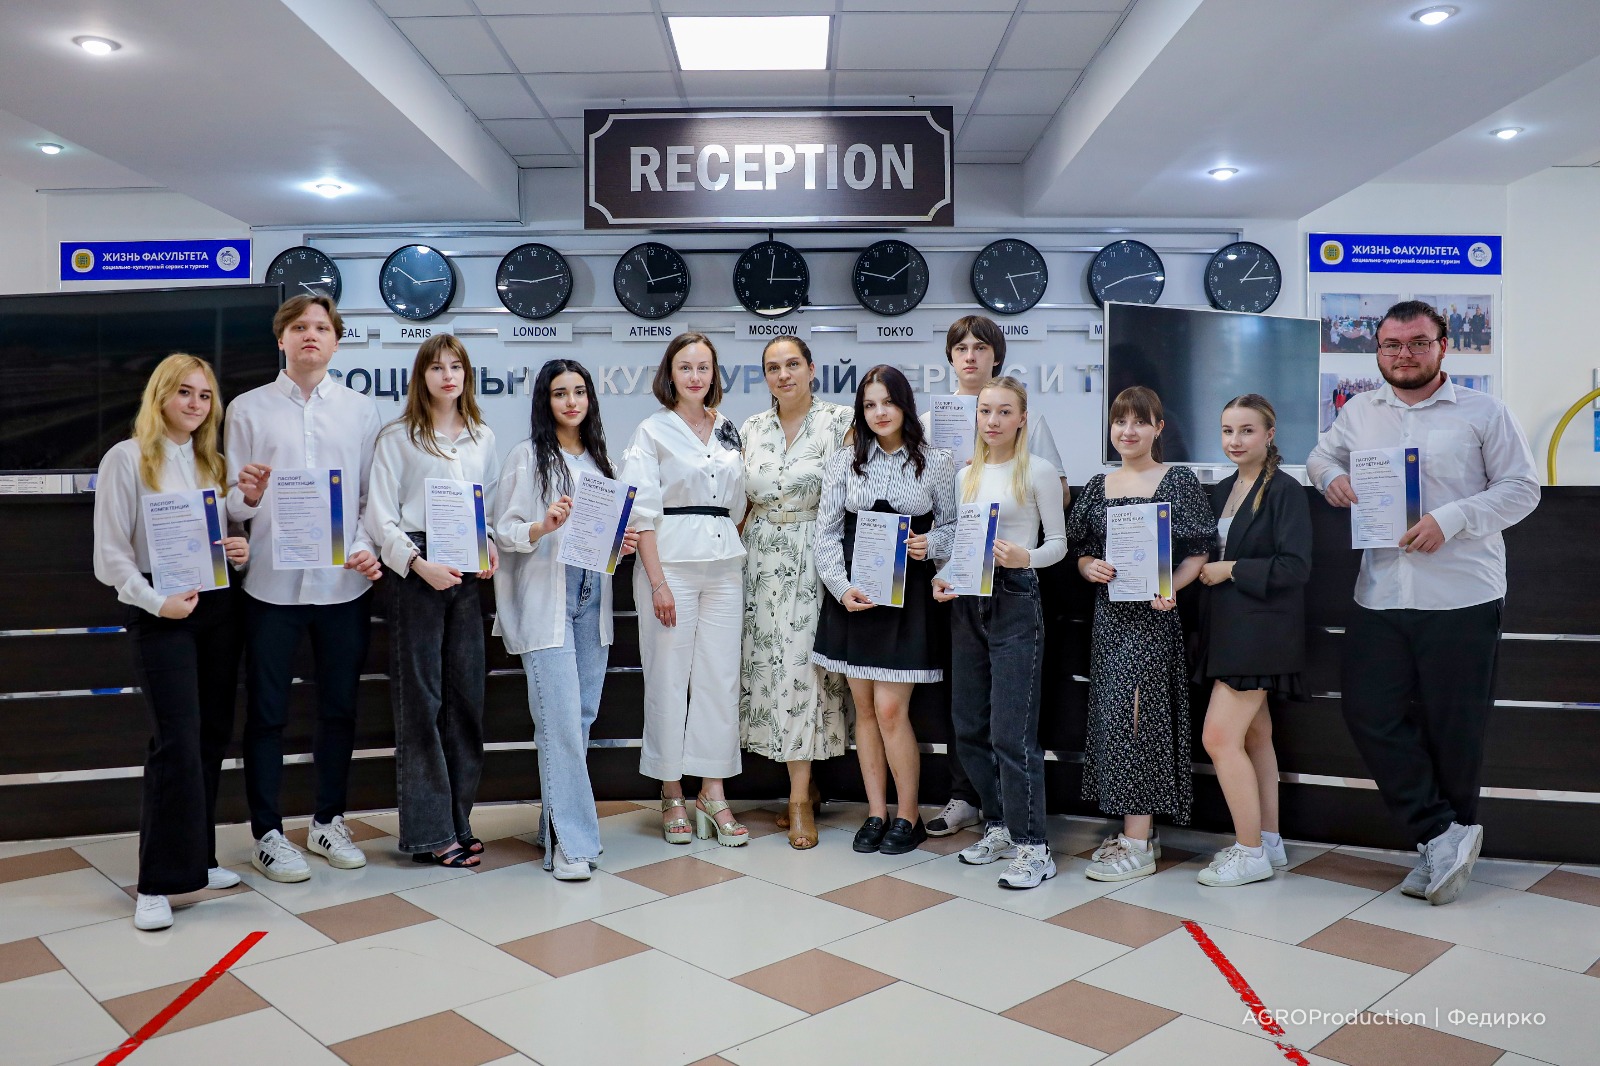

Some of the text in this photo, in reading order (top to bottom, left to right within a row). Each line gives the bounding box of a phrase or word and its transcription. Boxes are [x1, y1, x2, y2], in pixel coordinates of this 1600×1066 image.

[630, 144, 914, 192] RECEPTION
[1352, 246, 1460, 256] ЖИЗНЬ ФАКУЛЬТЕТА
[102, 252, 140, 262] ЖИЗНЬ
[142, 251, 209, 261] ФАКУЛЬТЕТА
[342, 328, 360, 338] EAL
[401, 329, 432, 338] PARIS
[514, 327, 557, 337] LONDON
[630, 326, 672, 336] ATHENS
[750, 325, 798, 335] MOSCOW
[877, 326, 913, 336] TOKYO
[1041, 364, 1064, 392] И
